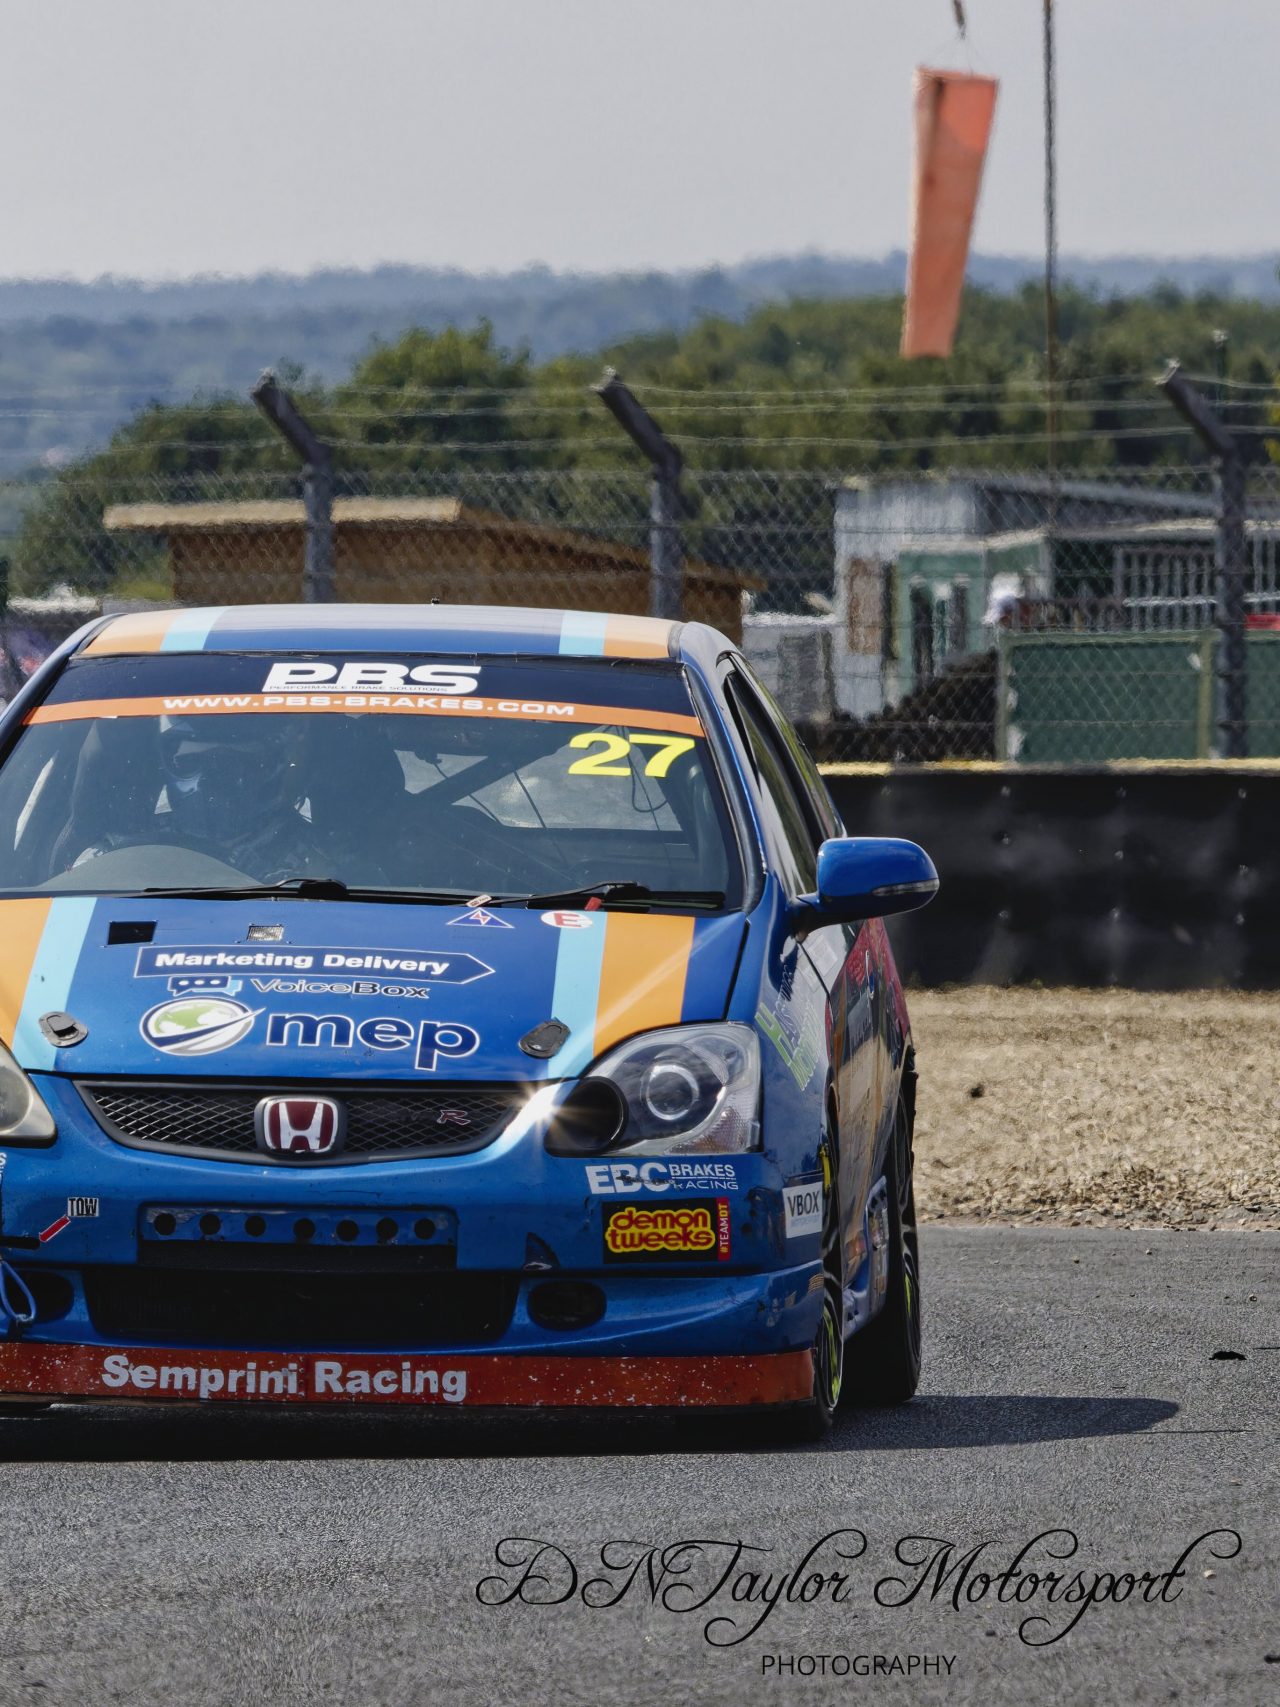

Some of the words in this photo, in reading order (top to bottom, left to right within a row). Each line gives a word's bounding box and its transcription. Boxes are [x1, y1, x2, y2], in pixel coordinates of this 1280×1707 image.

[262, 663, 481, 694] PBS
[163, 696, 575, 715] WWW.PBS-BRAKES.COM
[568, 733, 696, 777] 27
[553, 912, 581, 927] E
[155, 952, 313, 968] Marketing
[323, 953, 449, 974] Delivery
[250, 978, 430, 999] VoiceBox
[266, 1013, 480, 1071] mep
[585, 1162, 669, 1195] EBC
[669, 1164, 735, 1177] BRAKES
[69, 1198, 97, 1216] TOW
[787, 1191, 820, 1217] VBOX
[611, 1208, 710, 1229] demon
[607, 1227, 715, 1250] tweeks
[101, 1355, 299, 1399] Semprini
[315, 1361, 467, 1402] Racing
